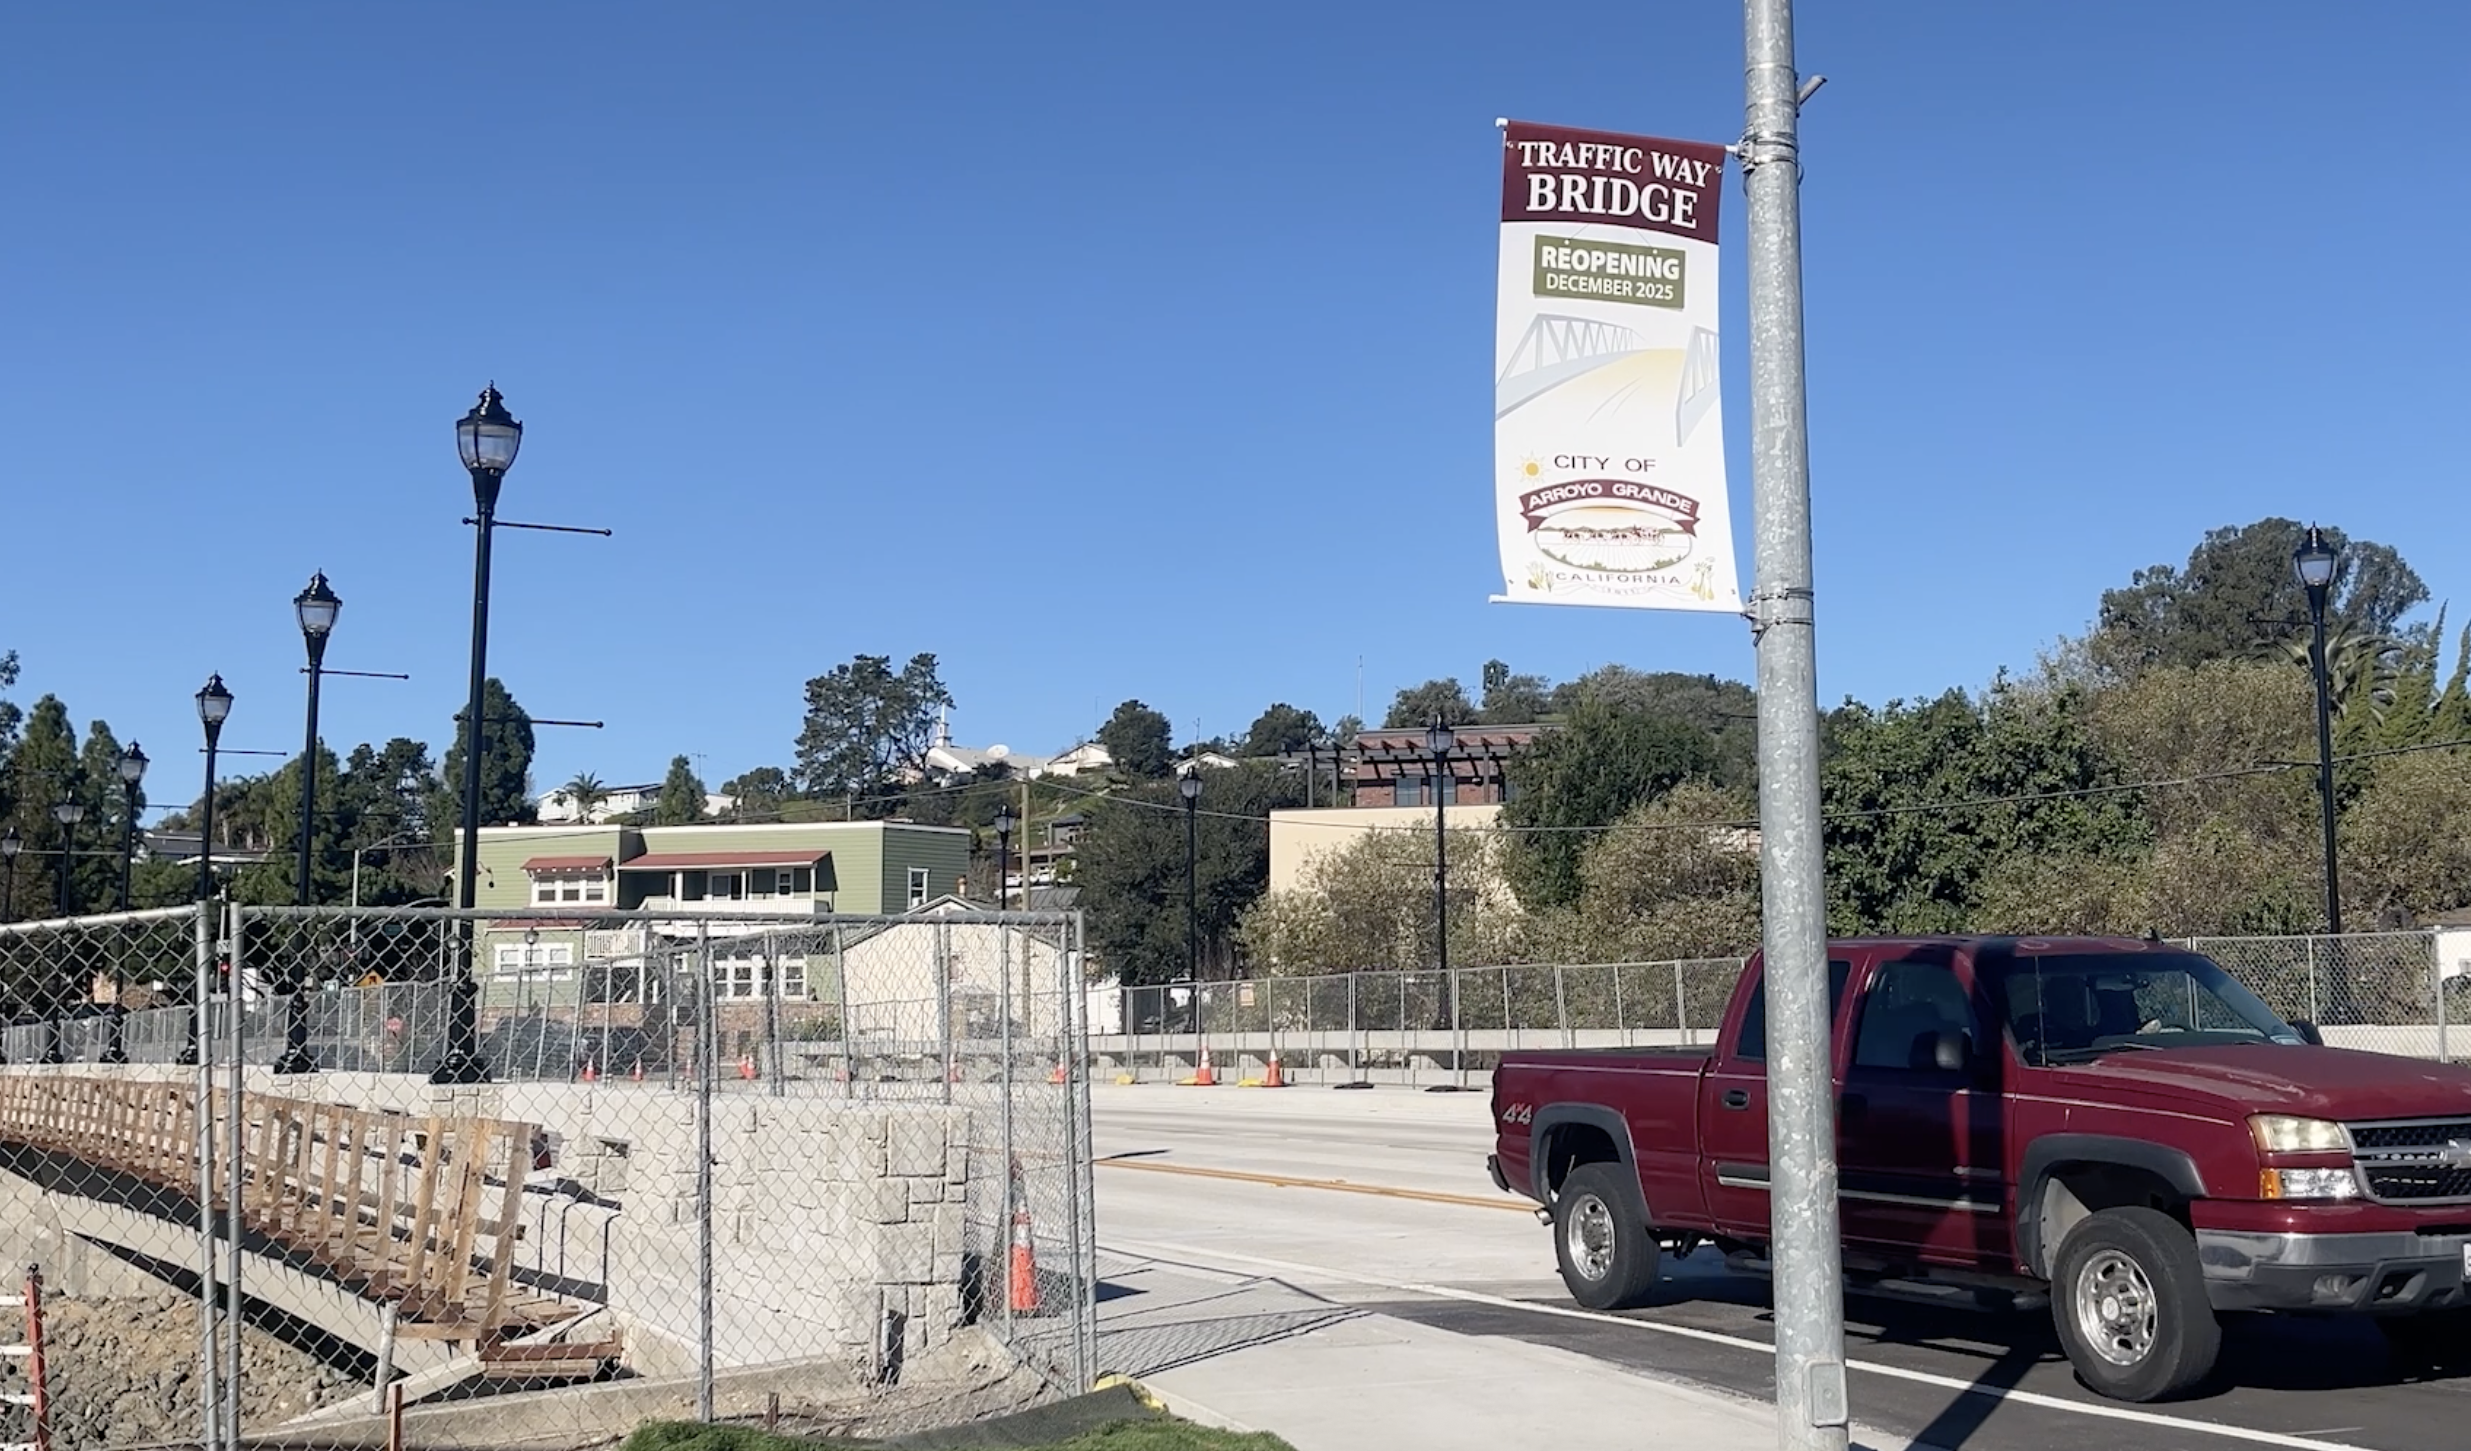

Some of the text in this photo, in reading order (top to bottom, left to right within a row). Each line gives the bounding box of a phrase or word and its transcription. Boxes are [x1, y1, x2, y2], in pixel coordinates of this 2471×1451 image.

[1518, 141, 1711, 188] TRAFFIC WAY
[1526, 173, 1698, 229] BRIDGE
[1541, 246, 1680, 280] REOPENING
[1546, 273, 1674, 300] DECEMBER 2025
[1554, 455, 1656, 473] CITY OF
[1529, 482, 1692, 513] ARROYO GRANDE
[1556, 572, 1681, 585] CALIFORNIA
